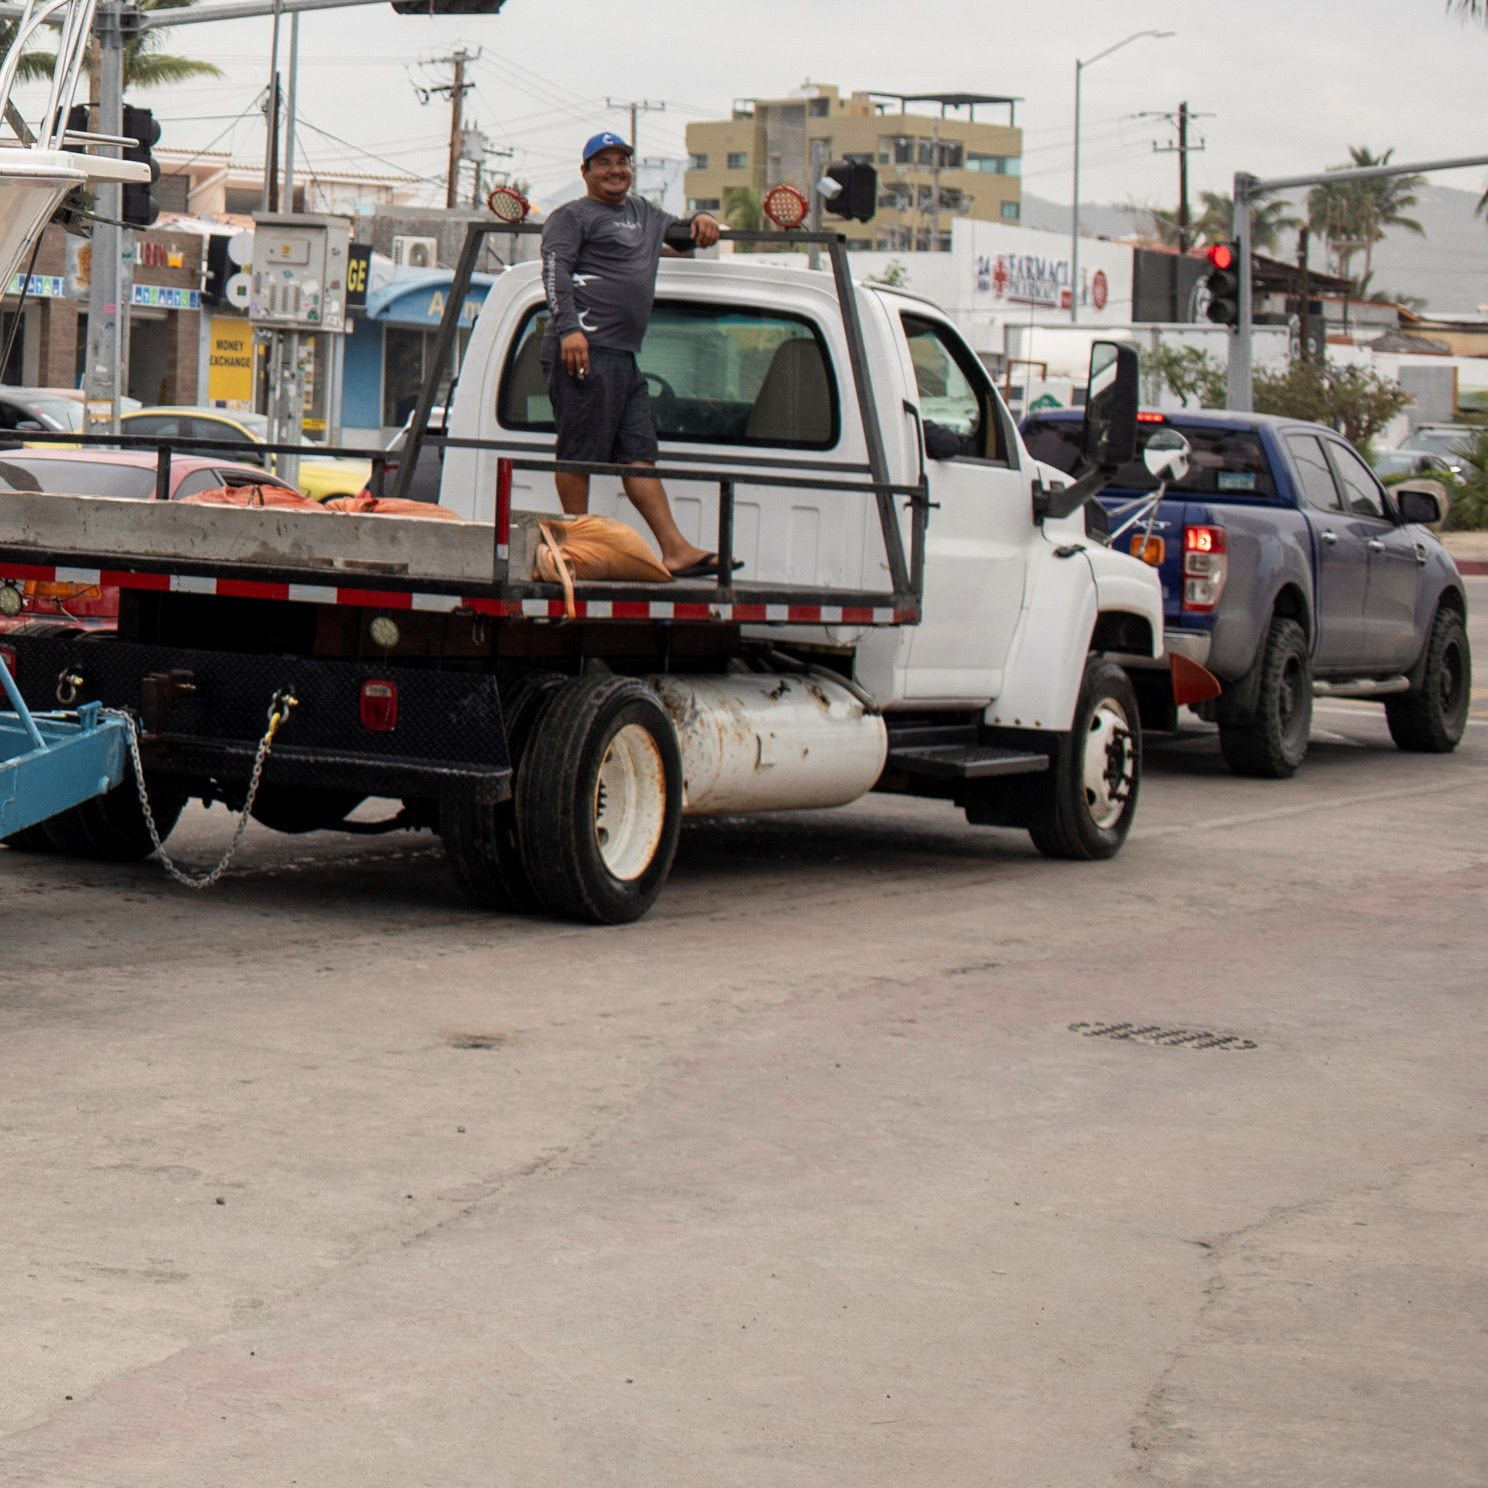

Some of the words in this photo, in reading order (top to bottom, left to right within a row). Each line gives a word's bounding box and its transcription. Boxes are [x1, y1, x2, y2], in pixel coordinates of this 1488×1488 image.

[1008, 253, 1070, 285] FARMACI
[216, 338, 245, 352] MONEY
[209, 355, 252, 369] EXCHANGE
